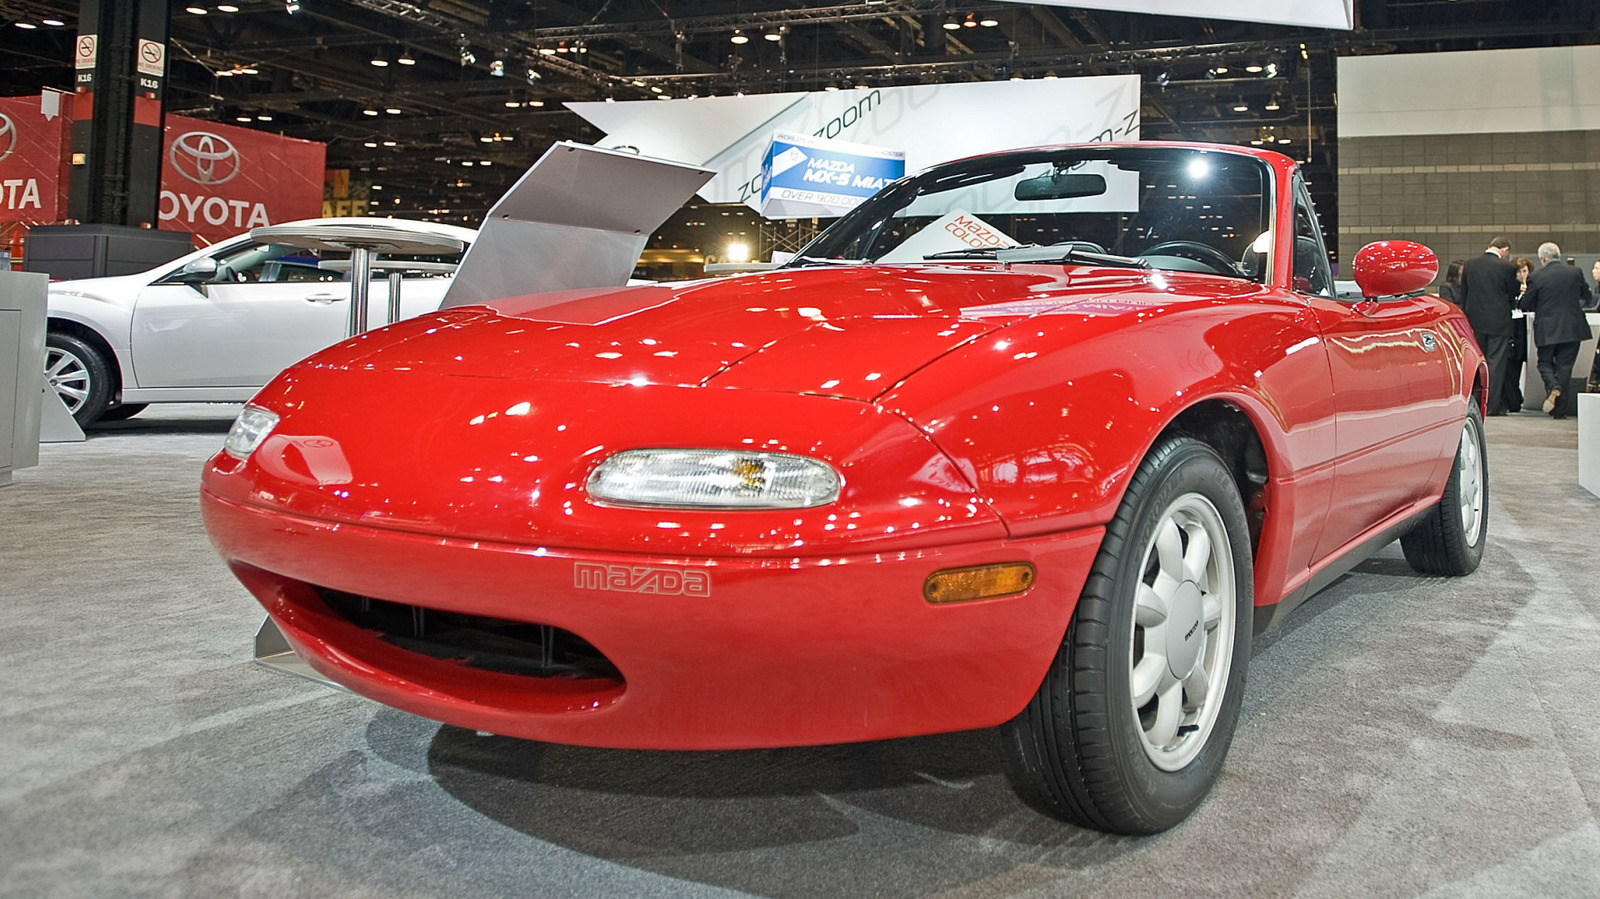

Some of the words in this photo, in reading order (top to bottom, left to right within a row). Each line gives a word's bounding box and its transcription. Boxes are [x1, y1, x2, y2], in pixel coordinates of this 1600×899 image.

[77, 73, 92, 82] K16
[140, 78, 158, 89] K16
[807, 157, 856, 173] MAZDA
[803, 169, 852, 186] MX-5
[852, 175, 896, 190] MIAT
[0, 178, 41, 209] TA
[781, 189, 813, 200] OVER
[159, 190, 270, 228] OYOTA
[574, 562, 710, 598] mazda
